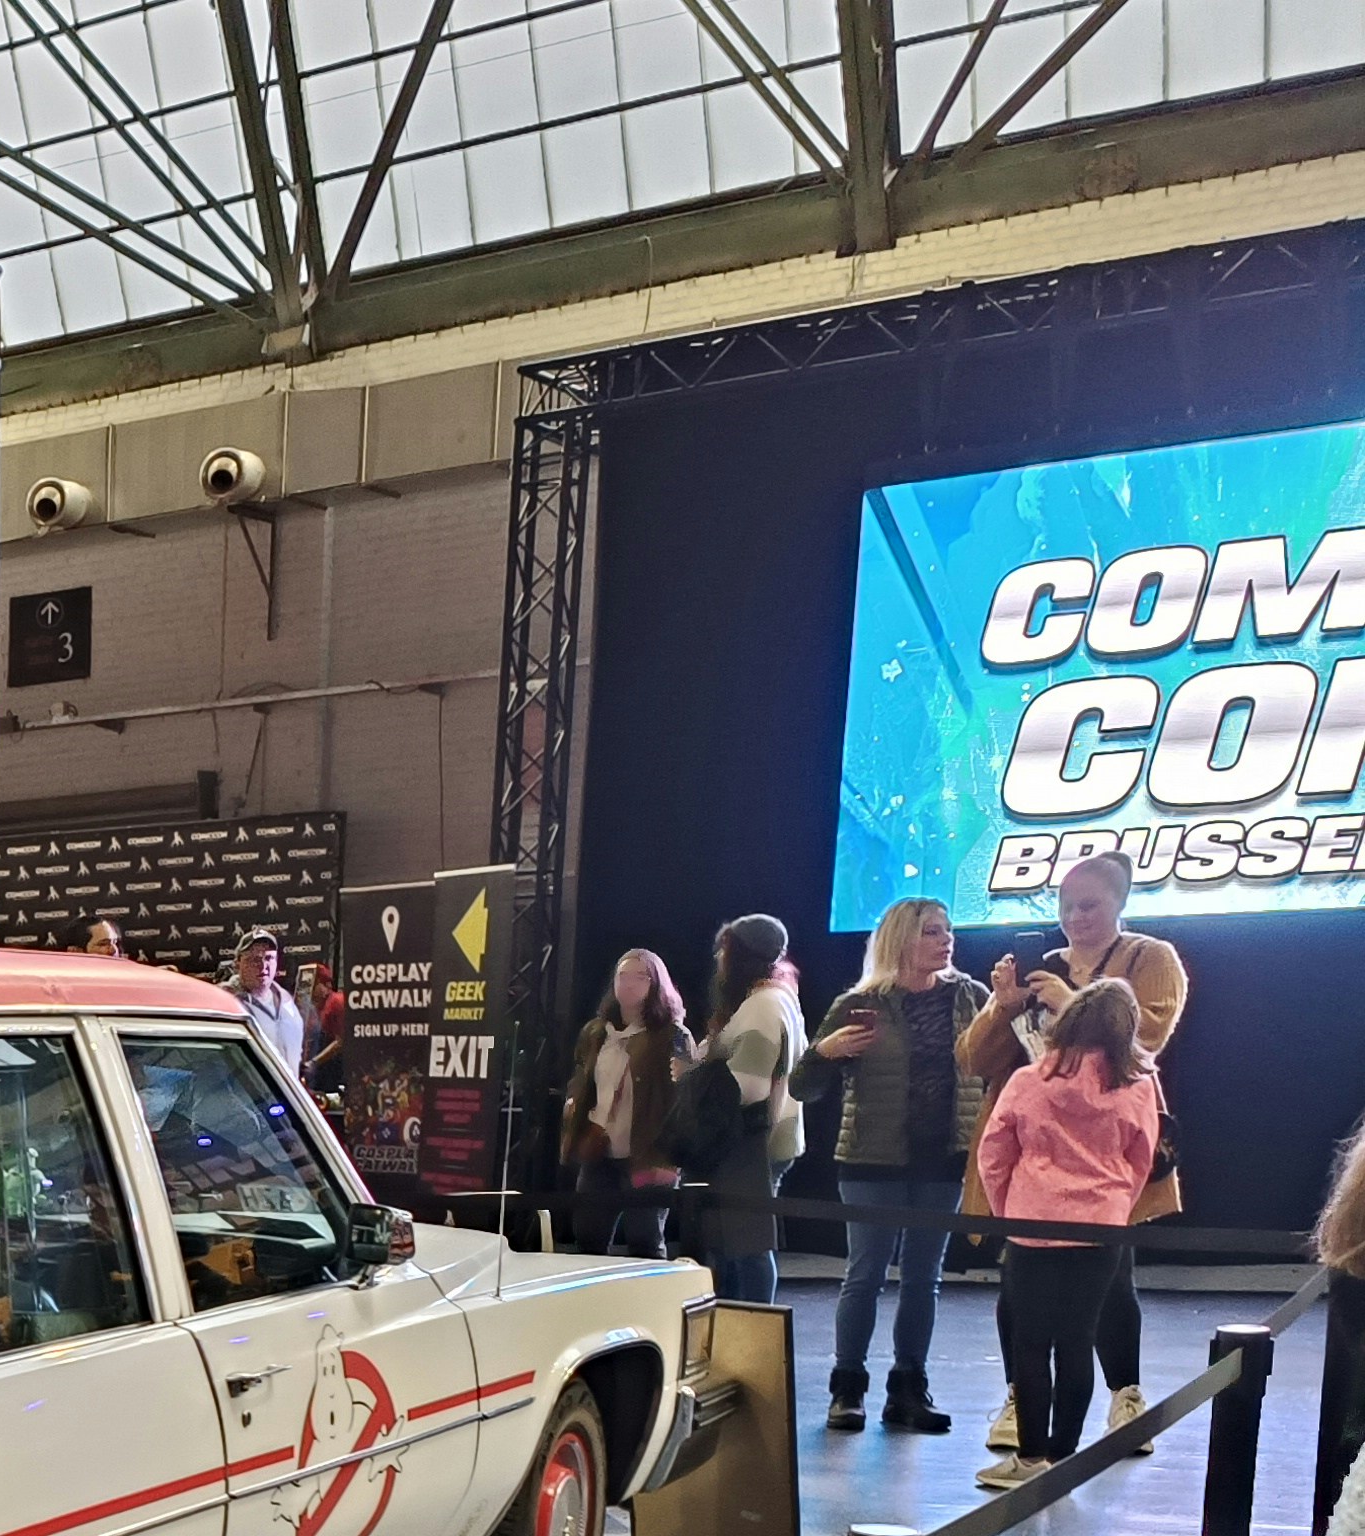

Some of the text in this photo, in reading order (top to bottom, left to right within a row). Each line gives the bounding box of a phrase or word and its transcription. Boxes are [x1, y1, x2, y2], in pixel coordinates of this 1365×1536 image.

[57, 632, 74, 663] 3
[987, 814, 1365, 896] BRUSSE
[351, 962, 432, 985] COSPLAY
[445, 981, 486, 1002] GEEK
[443, 1007, 485, 1020] MARKET
[354, 1024, 381, 1038] SIGN
[383, 1023, 399, 1037] UP
[429, 1035, 494, 1079] EXIT
